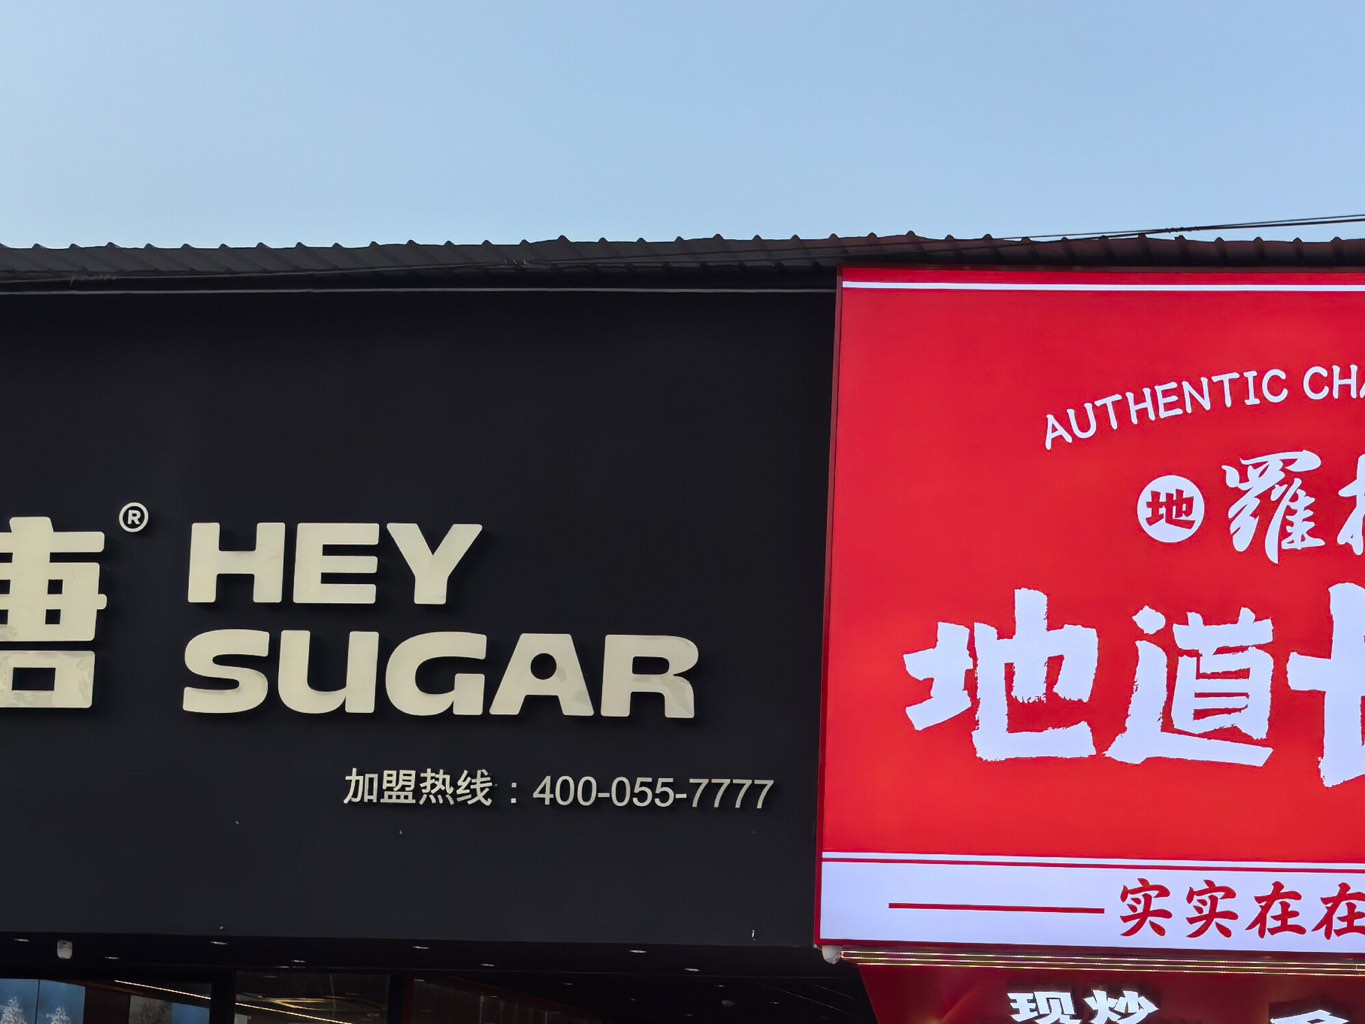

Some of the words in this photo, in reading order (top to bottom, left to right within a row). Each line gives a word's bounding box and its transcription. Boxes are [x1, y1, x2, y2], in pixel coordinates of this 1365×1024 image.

[1044, 369, 1290, 451] AUTHENTIC
[188, 522, 483, 605] HEY
[182, 629, 699, 718] SUGAR
